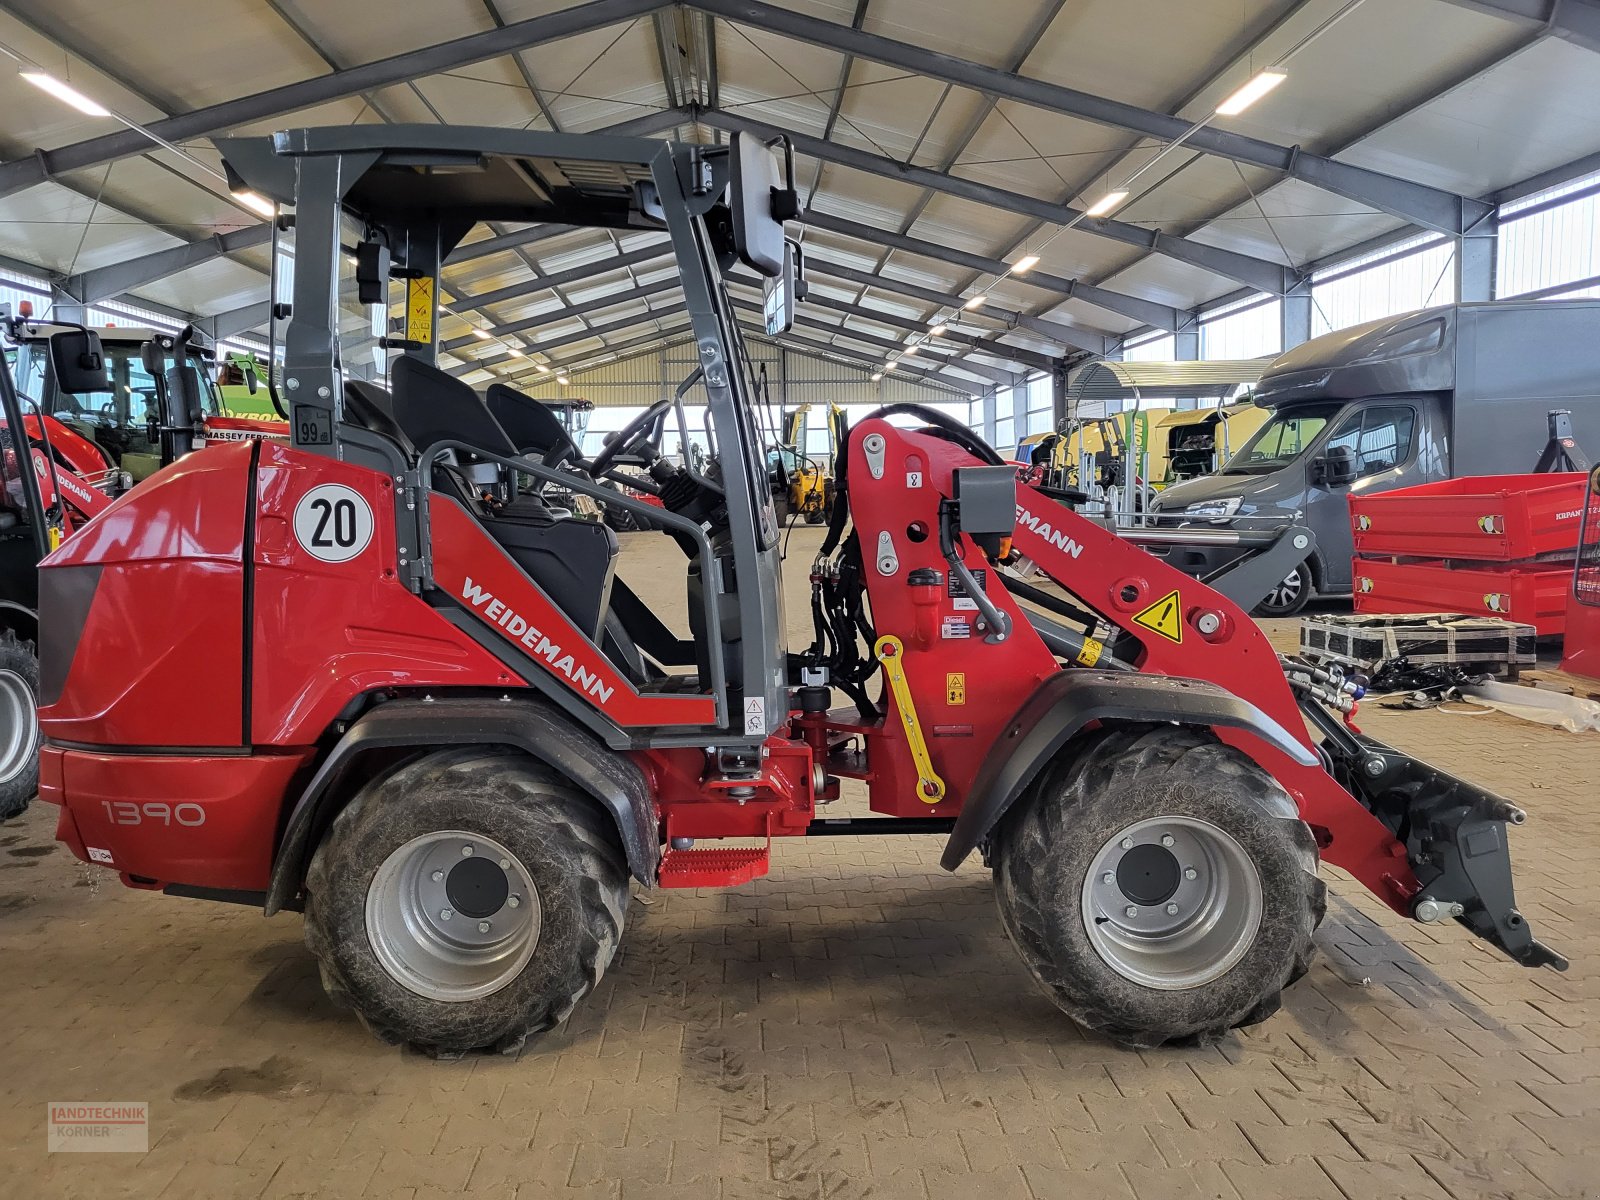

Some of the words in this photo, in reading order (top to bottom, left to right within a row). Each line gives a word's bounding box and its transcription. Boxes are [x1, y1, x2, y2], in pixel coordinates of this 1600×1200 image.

[204, 432, 243, 440] MASSEY
[302, 423, 318, 442] 99
[311, 498, 356, 547] 20
[462, 576, 615, 704] WEIDEMANN
[101, 800, 206, 827] 1390
